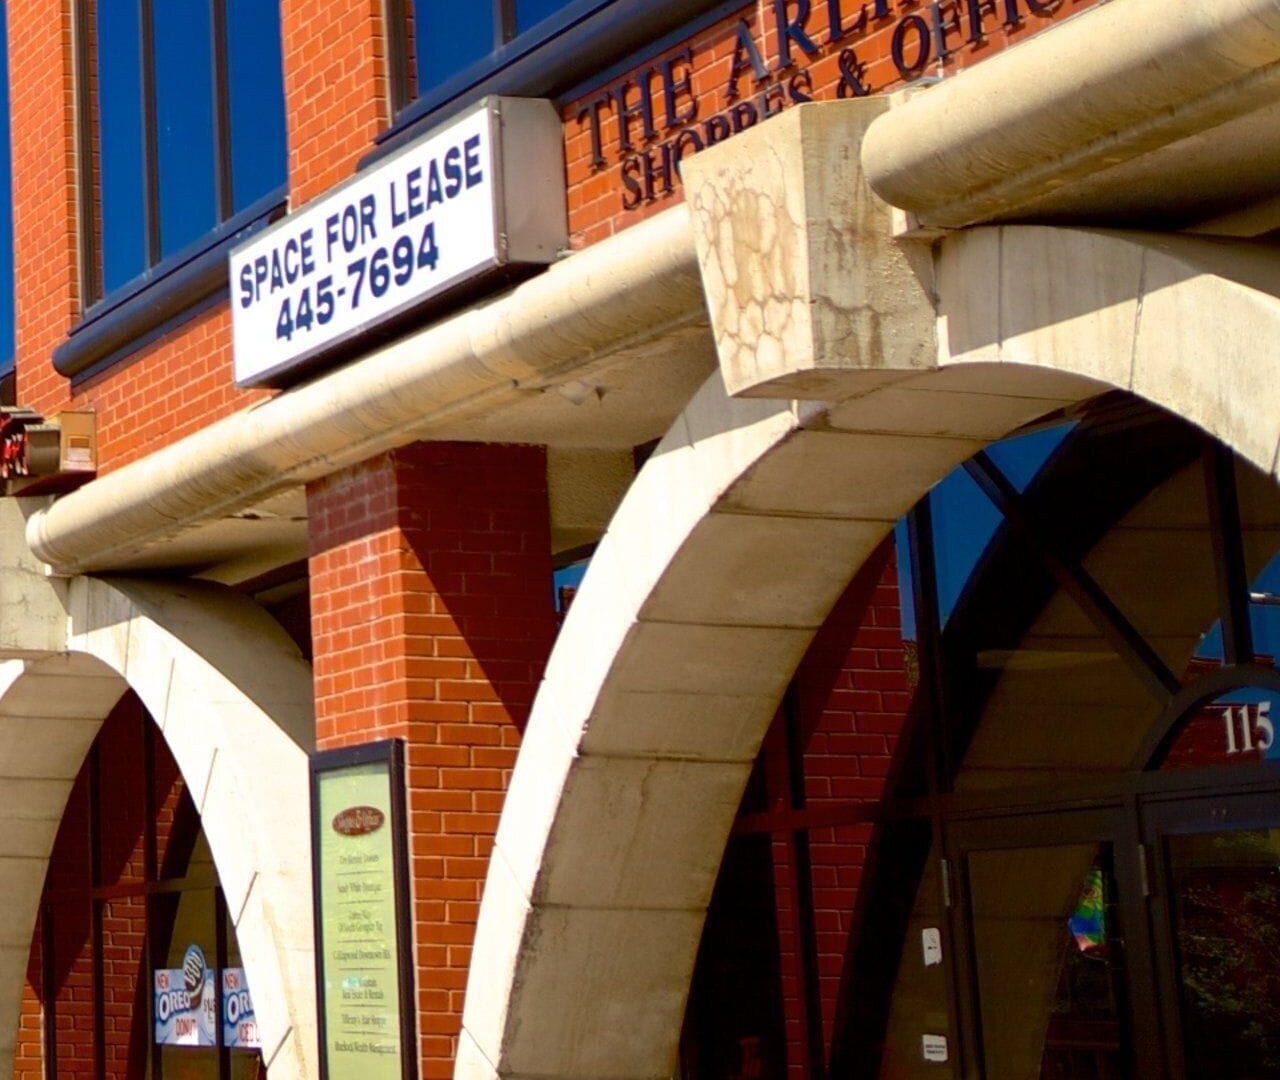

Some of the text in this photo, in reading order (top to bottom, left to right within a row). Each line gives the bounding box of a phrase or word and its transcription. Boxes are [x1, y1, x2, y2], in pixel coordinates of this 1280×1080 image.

[577, 47, 698, 168] THE
[836, 47, 870, 99] &
[240, 133, 484, 309] SPACE FOR LEASE
[275, 222, 440, 342] 445-7694
[1222, 701, 1274, 753] 115
[159, 991, 192, 1021] OREO
